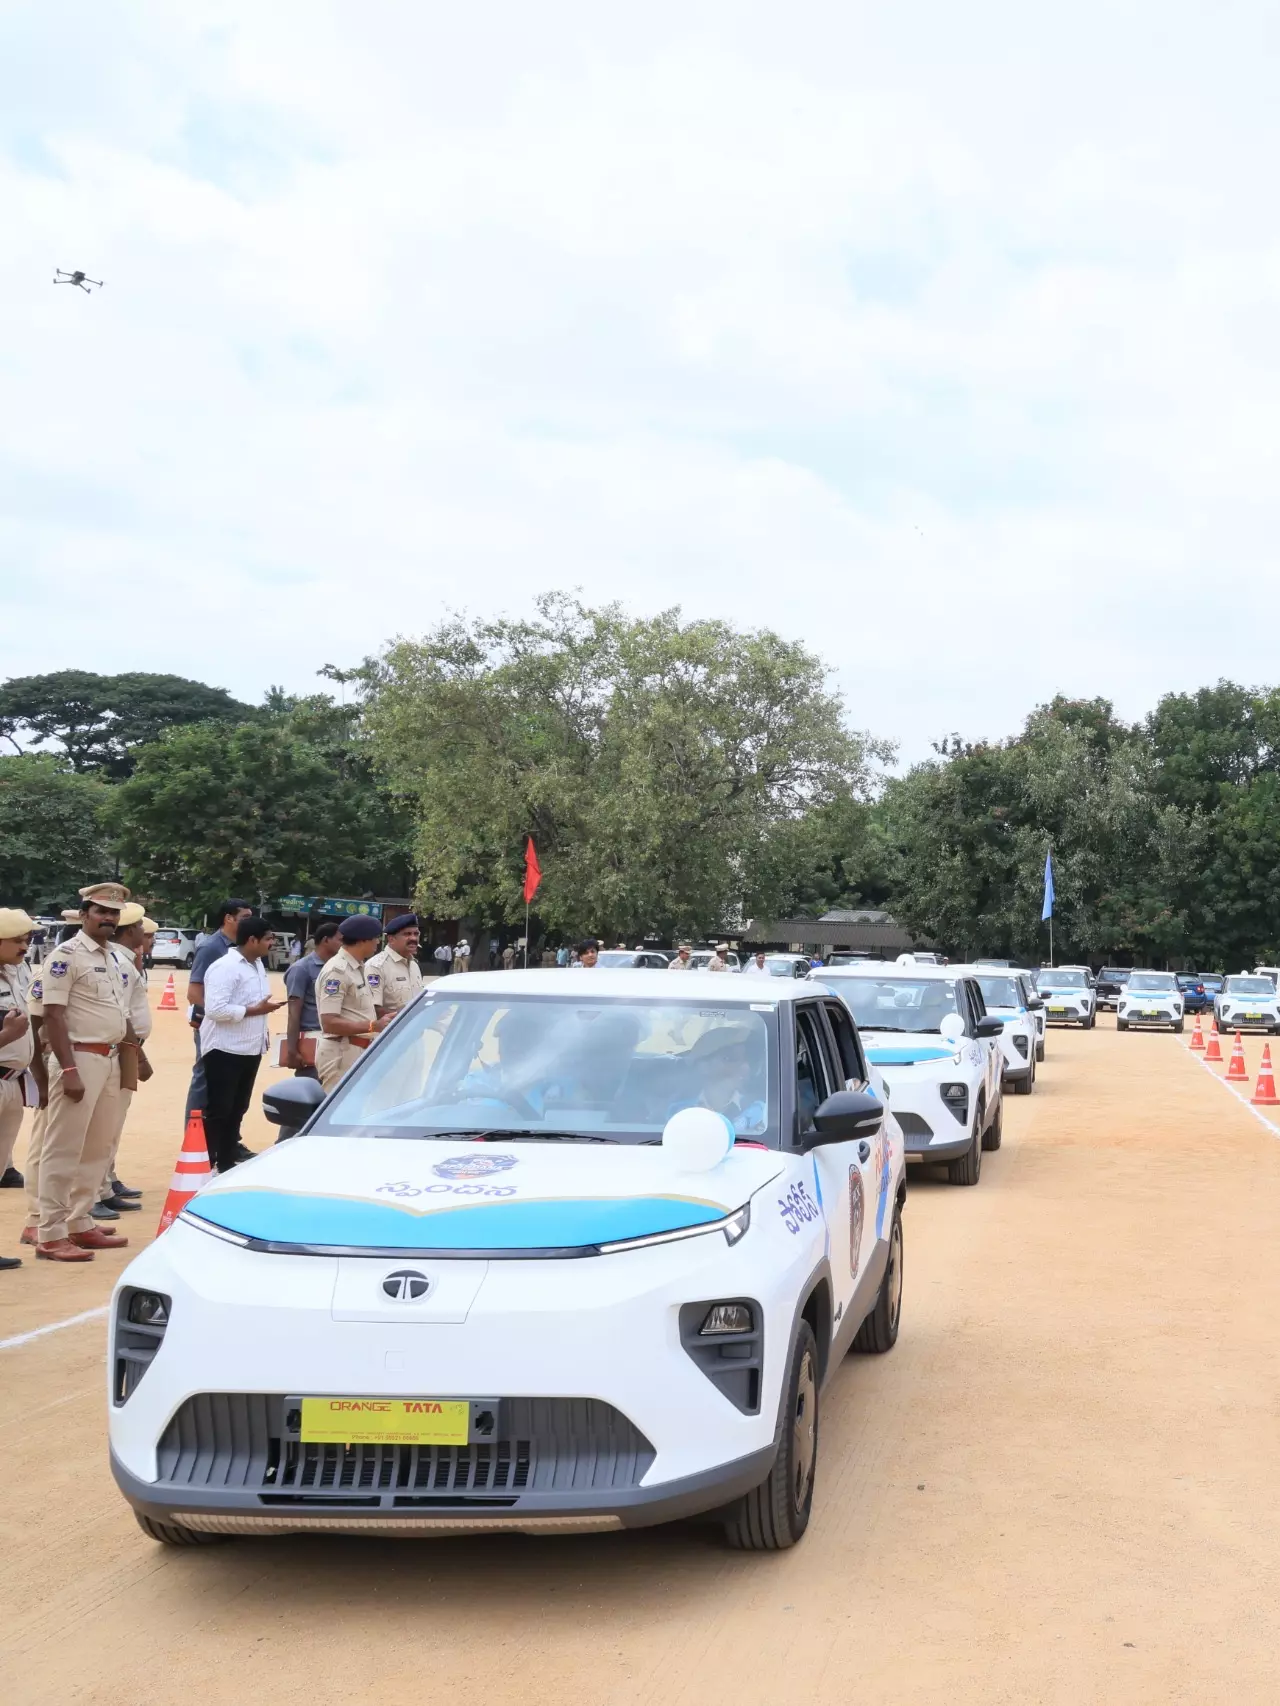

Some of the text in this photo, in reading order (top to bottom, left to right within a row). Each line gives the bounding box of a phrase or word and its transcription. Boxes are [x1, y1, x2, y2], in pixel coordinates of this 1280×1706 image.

[375, 1181, 518, 1197] స్పందన
[330, 1401, 443, 1413] ORANGE TATA
